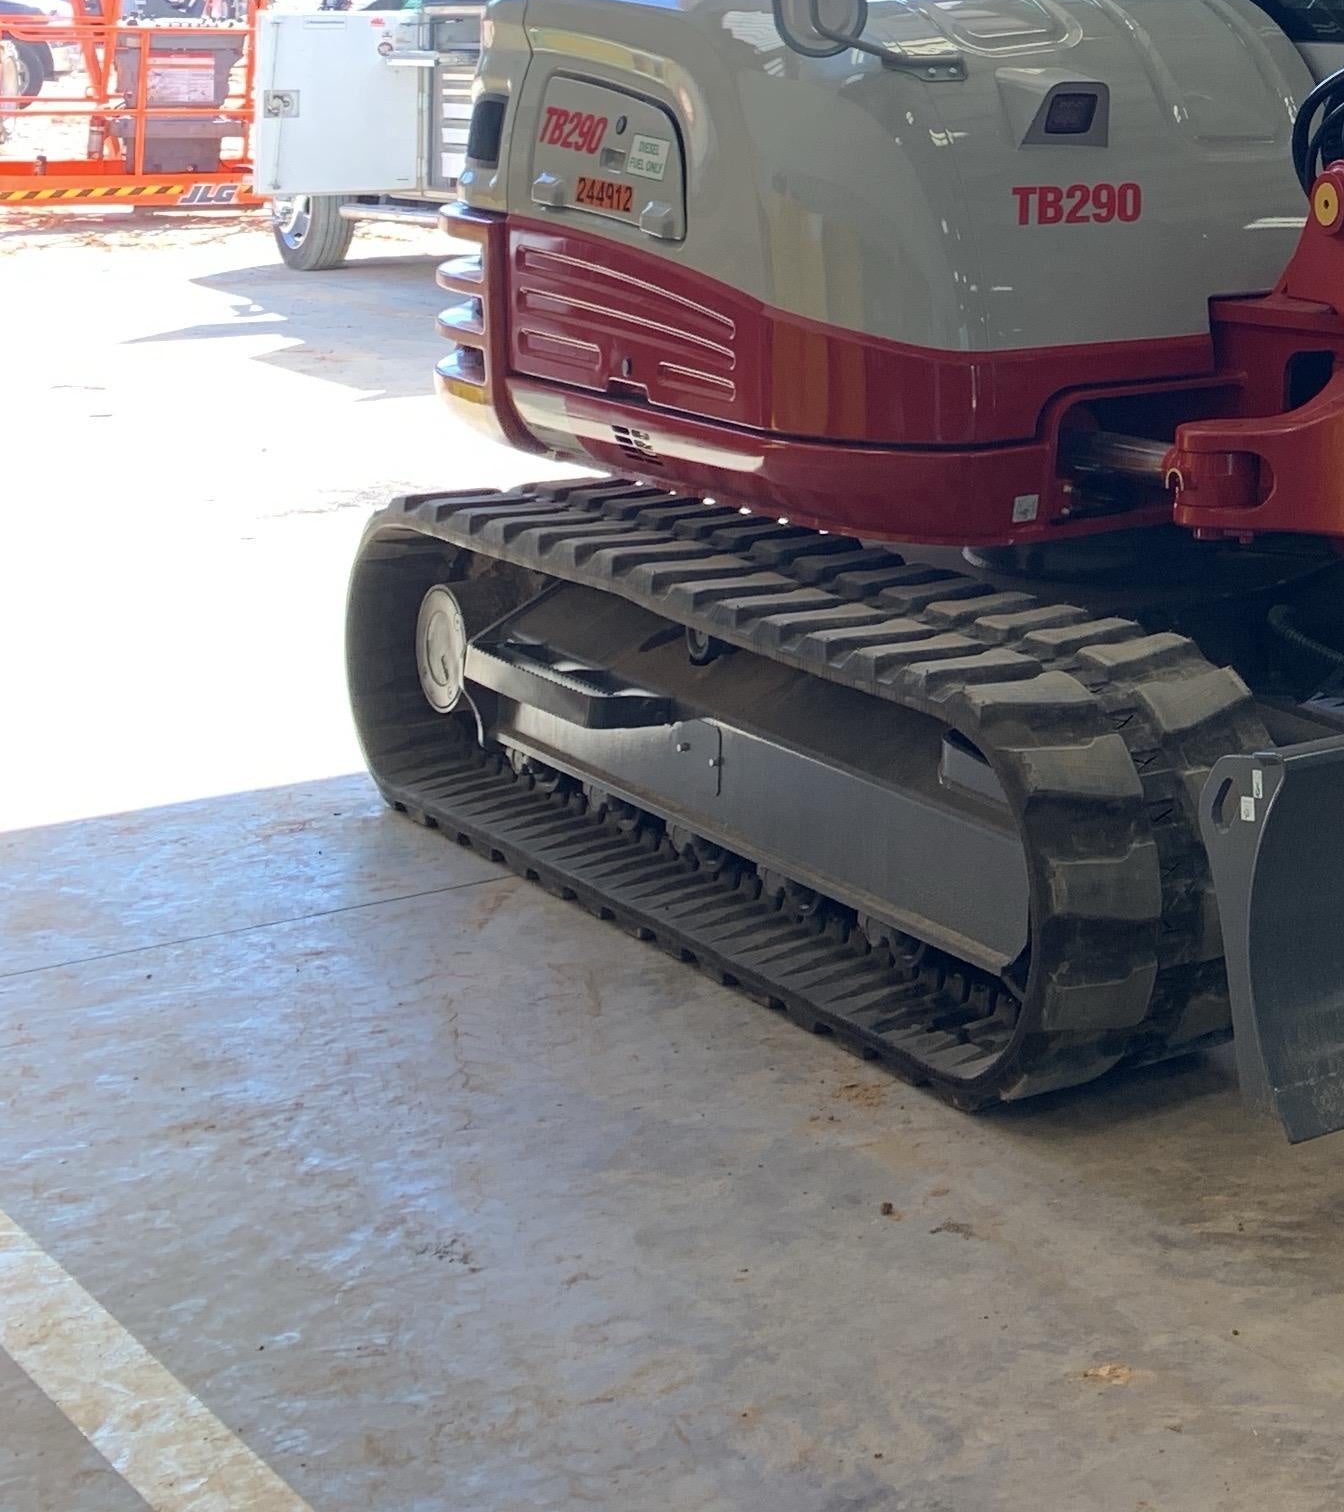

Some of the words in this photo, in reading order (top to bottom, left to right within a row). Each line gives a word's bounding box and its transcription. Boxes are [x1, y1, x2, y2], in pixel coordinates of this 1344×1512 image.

[539, 106, 608, 154] TB290
[629, 157, 644, 171] FUEL
[645, 161, 663, 174] ONLY
[178, 184, 239, 204] JLG
[576, 177, 633, 212] 244912
[1011, 182, 1142, 226] TB290
